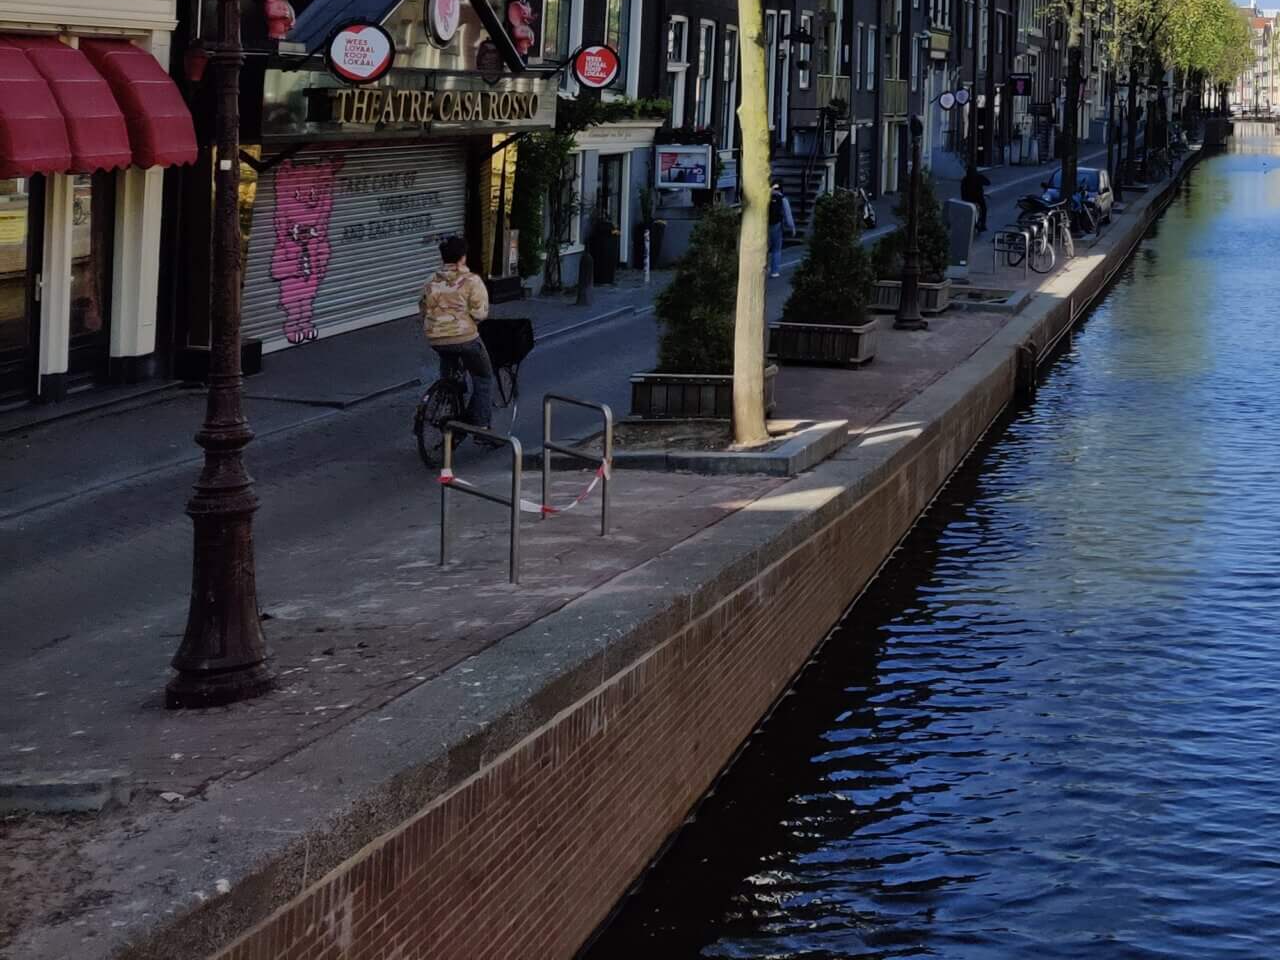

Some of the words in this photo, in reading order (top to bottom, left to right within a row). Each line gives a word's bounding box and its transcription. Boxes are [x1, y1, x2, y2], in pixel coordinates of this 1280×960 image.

[345, 45, 375, 53] LOYAAL
[336, 90, 434, 123] THEATRE
[440, 91, 482, 121] CASA
[488, 91, 540, 120] ROSSO
